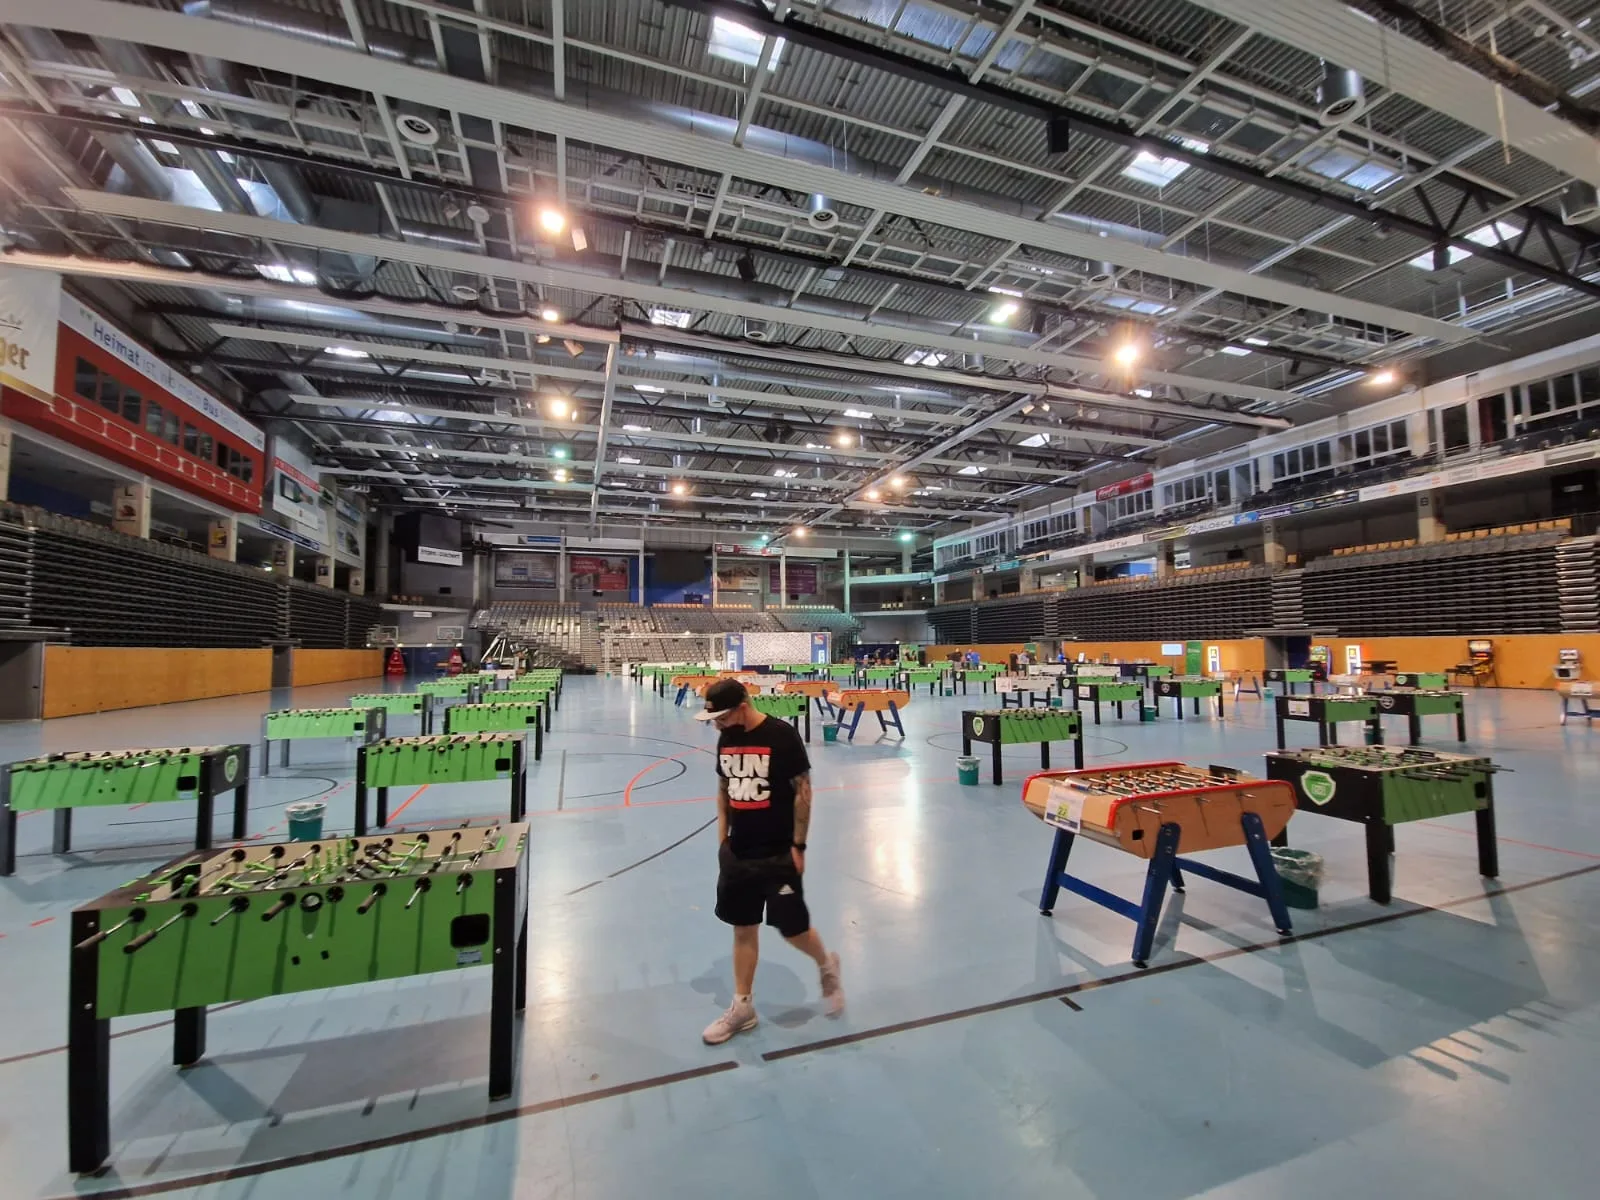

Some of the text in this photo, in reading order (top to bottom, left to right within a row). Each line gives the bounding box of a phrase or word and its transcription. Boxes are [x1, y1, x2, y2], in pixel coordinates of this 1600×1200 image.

[93, 321, 140, 367] Heimat
[720, 754, 770, 778] RUN
[727, 777, 771, 802] MC
